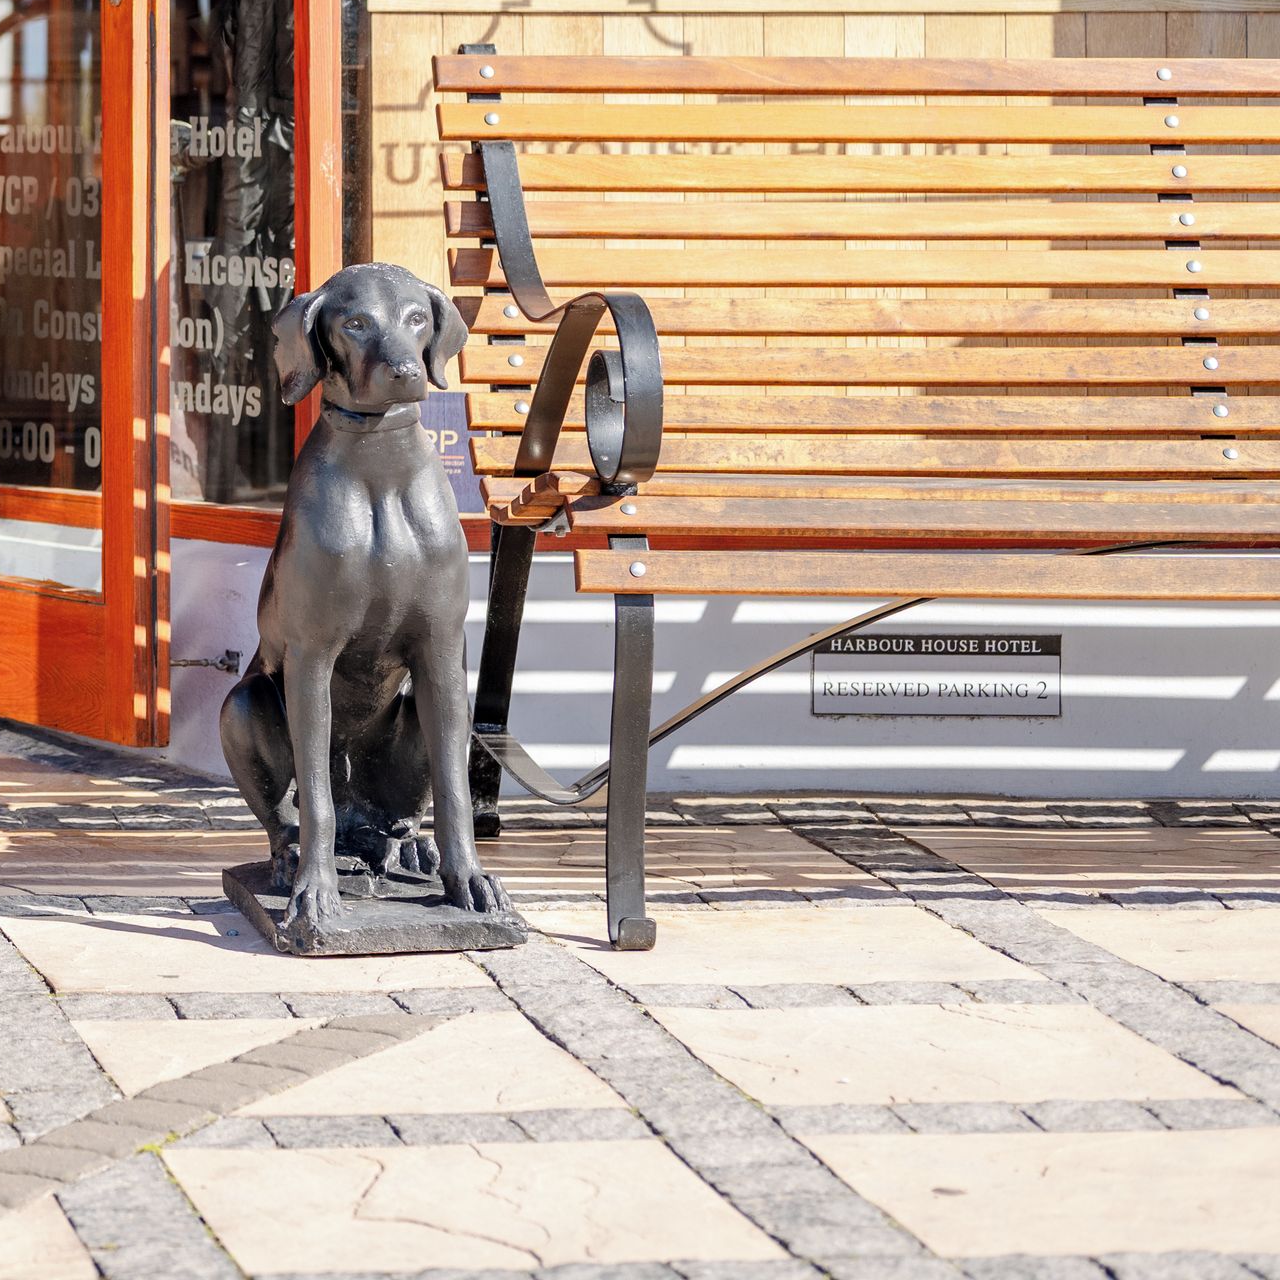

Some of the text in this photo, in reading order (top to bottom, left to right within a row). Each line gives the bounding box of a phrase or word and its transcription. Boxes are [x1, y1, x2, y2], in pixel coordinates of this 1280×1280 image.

[189, 116, 262, 157] Hotel
[185, 242, 296, 288] License
[831, 639, 1042, 653] HARBOUR HOUSE HOTEL
[822, 682, 1049, 699] RESERVED PARKING 2
